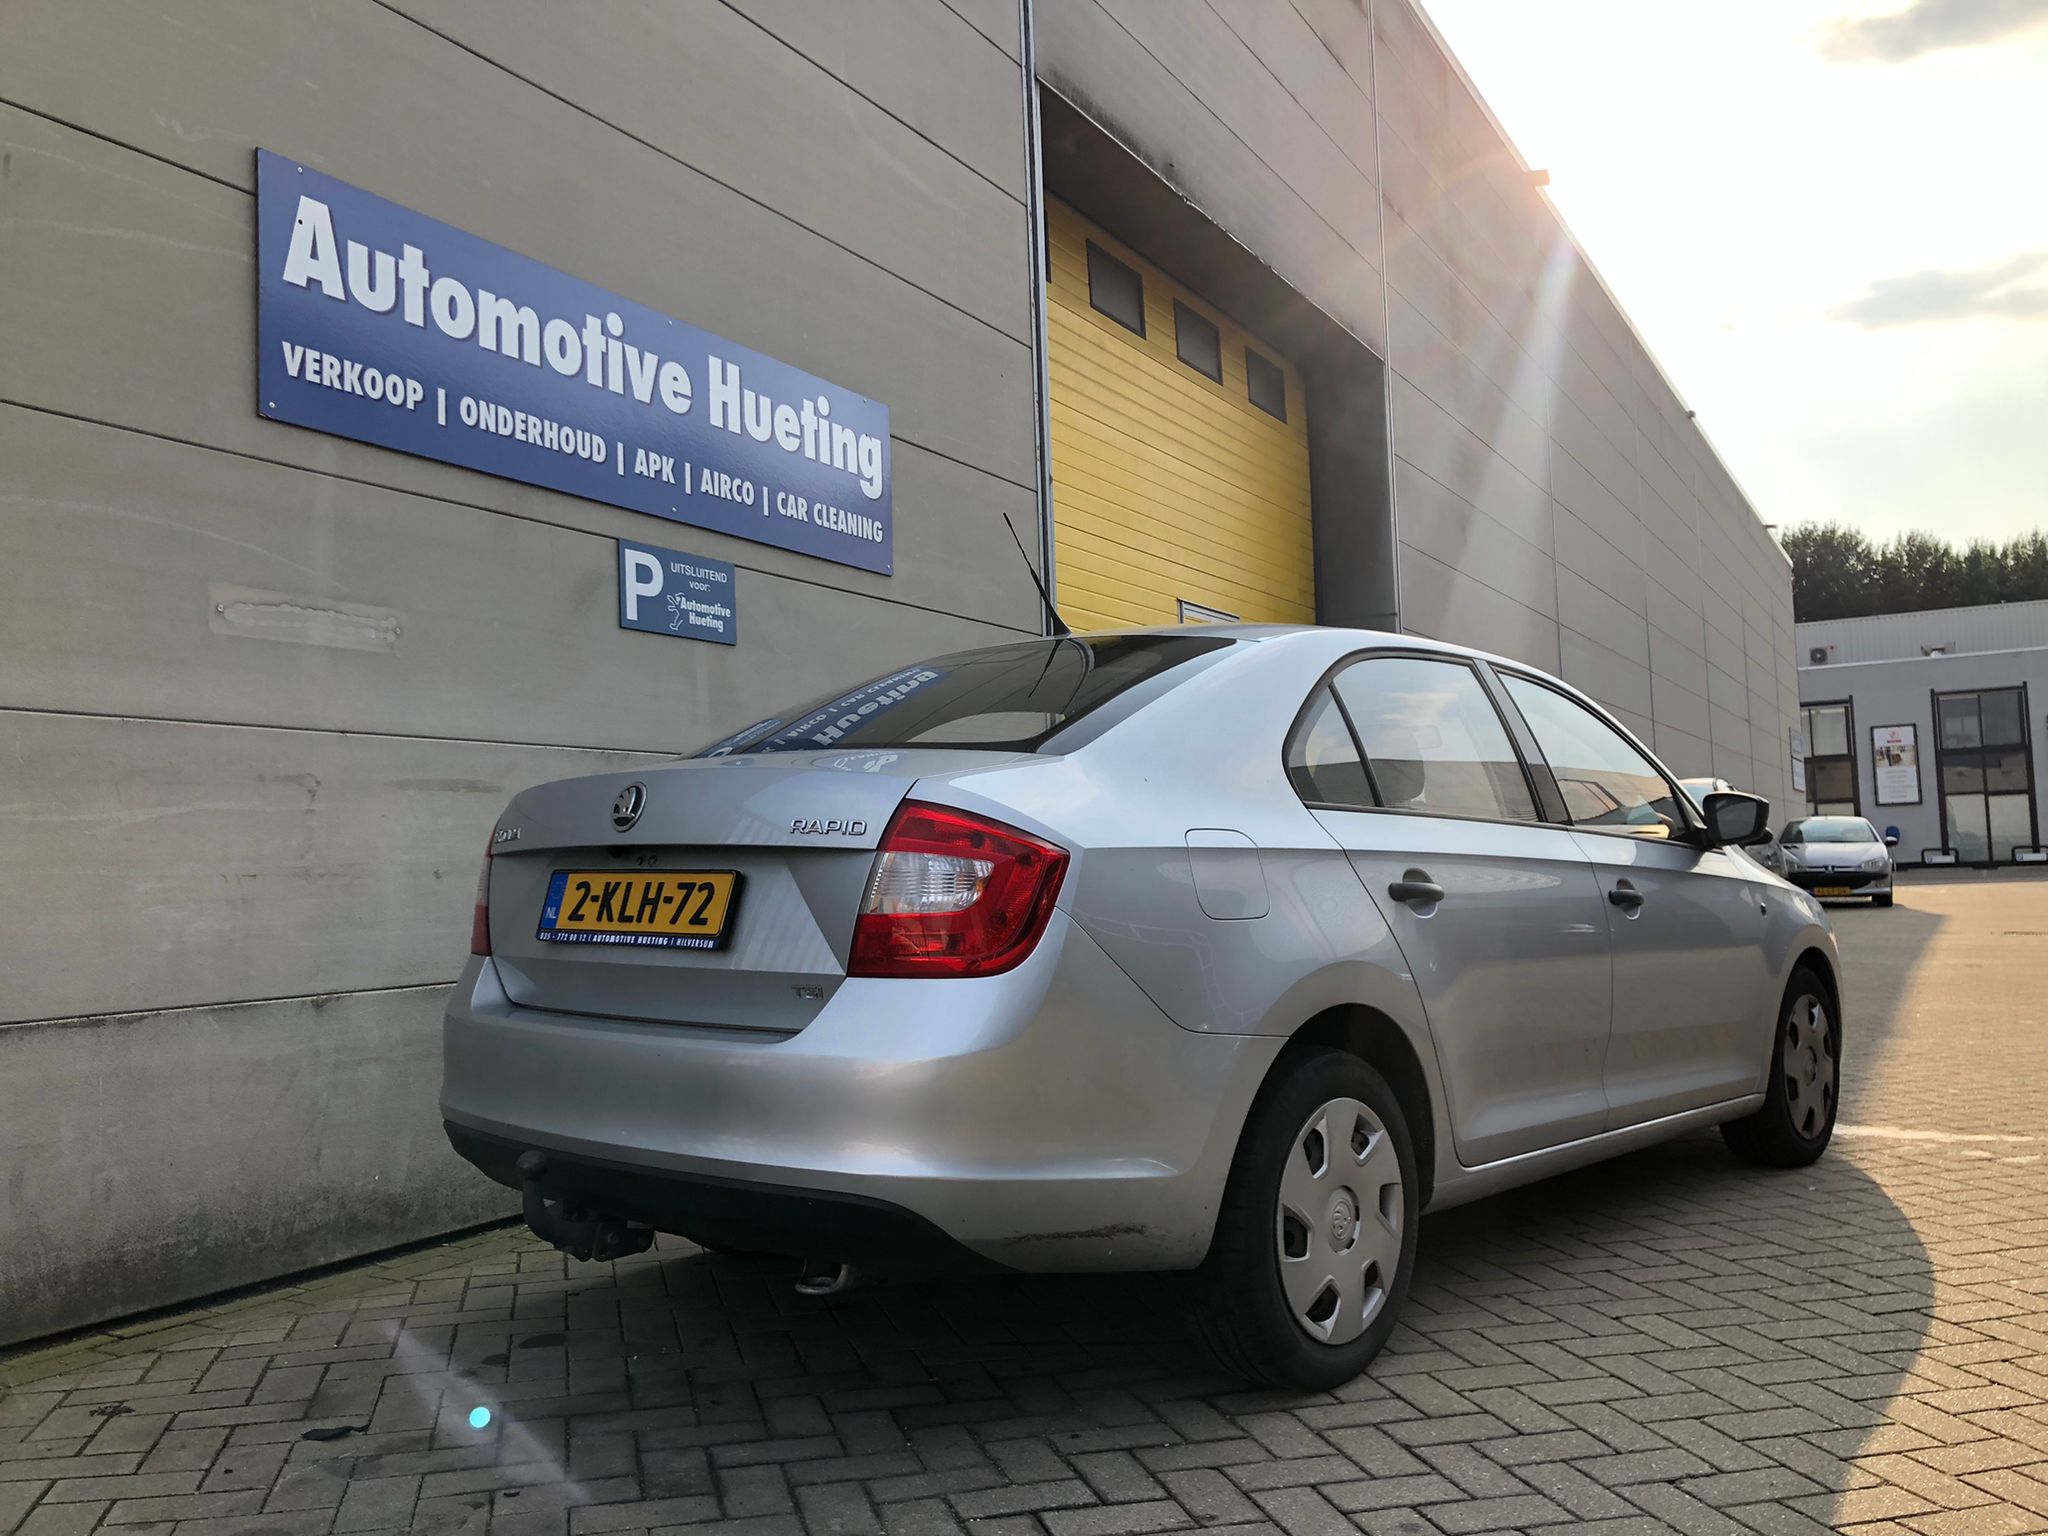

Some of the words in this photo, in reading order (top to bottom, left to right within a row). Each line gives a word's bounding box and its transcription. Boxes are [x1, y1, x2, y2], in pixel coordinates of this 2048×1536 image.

[282, 195, 693, 414] Automotive
[708, 354, 883, 500] Hueting
[281, 340, 424, 411] VERKOOP
[459, 395, 607, 463] ONDERHOUD
[634, 448, 676, 485] APK
[700, 468, 755, 506] AIRCO
[776, 491, 809, 523] CAR
[813, 502, 883, 544] CLEANING
[670, 562, 728, 583] UITSLUITEND
[624, 548, 664, 621] P
[680, 596, 731, 618] Automotive
[688, 612, 724, 633] Hueting
[789, 818, 868, 837] RAPID
[545, 906, 557, 919] NL
[567, 880, 716, 926] 2-KLH-72
[592, 934, 635, 944] AUTOMOTIVE
[637, 936, 669, 946] HUETING
[676, 938, 714, 948] HILVERSUM
